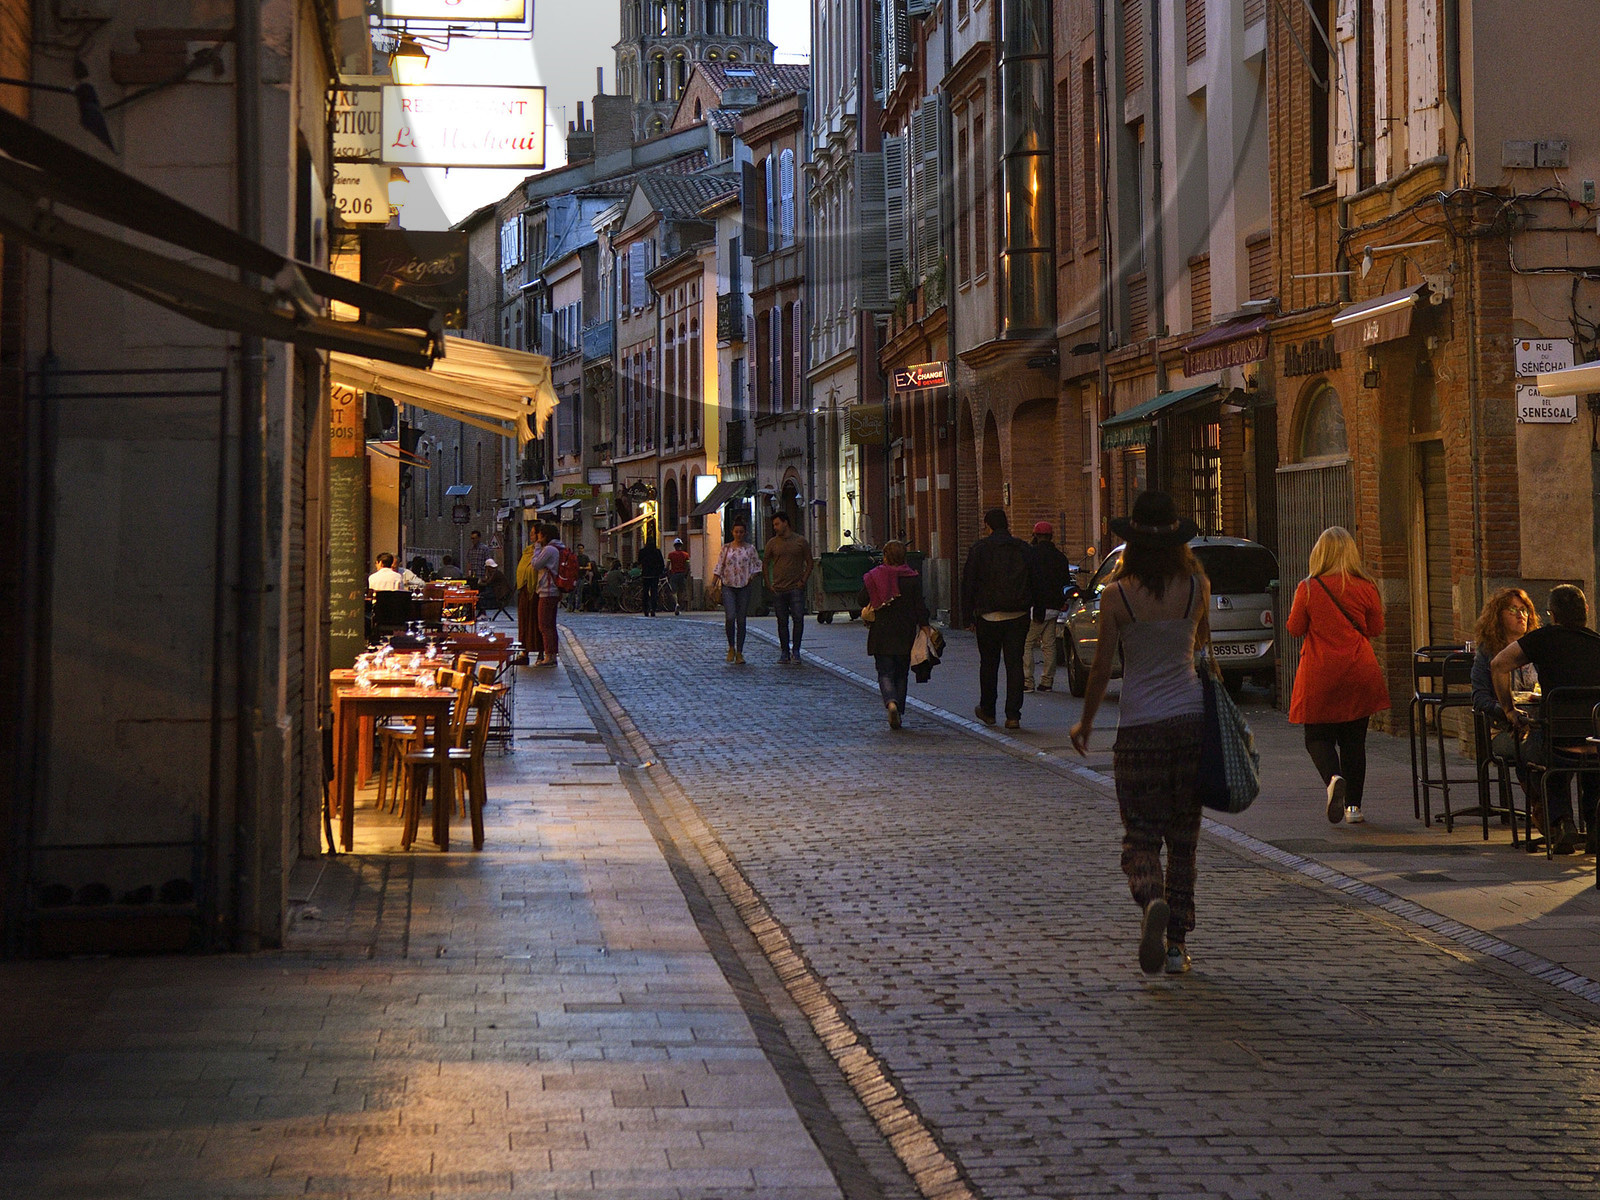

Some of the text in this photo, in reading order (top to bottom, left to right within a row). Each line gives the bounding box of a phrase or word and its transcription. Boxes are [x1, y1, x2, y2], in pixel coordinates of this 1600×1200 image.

[1535, 343, 1553, 351] RUE
[917, 370, 944, 381] CHANGE
[1522, 407, 1573, 418] SENESCAL
[1264, 611, 1273, 625] A
